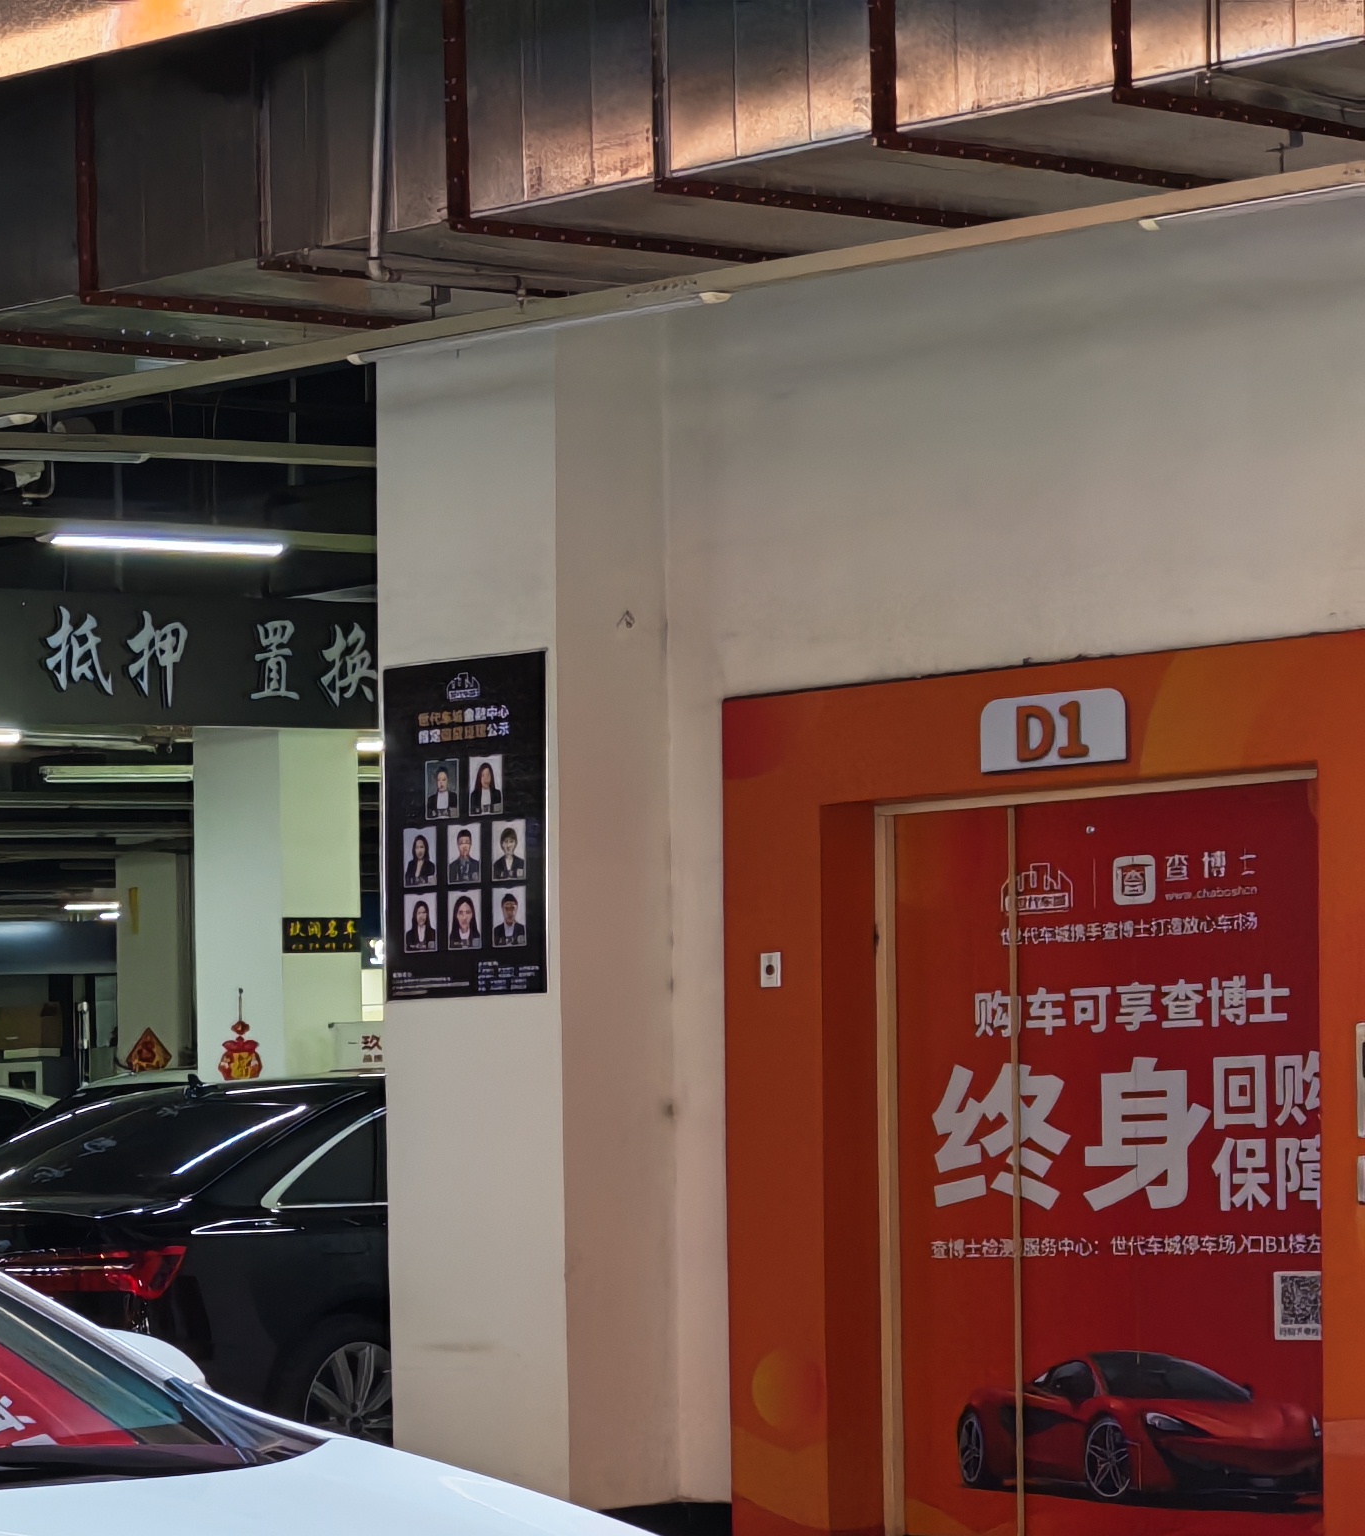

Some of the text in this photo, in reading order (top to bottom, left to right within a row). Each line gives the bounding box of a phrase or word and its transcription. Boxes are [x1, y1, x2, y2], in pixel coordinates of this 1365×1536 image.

[44, 604, 188, 707] 抵押
[250, 619, 378, 709] 置换
[1014, 699, 1090, 763] D1
[1164, 847, 1258, 883] 查博士
[973, 972, 1291, 1039] 购车可享查博士
[931, 1056, 1211, 1213] 终身
